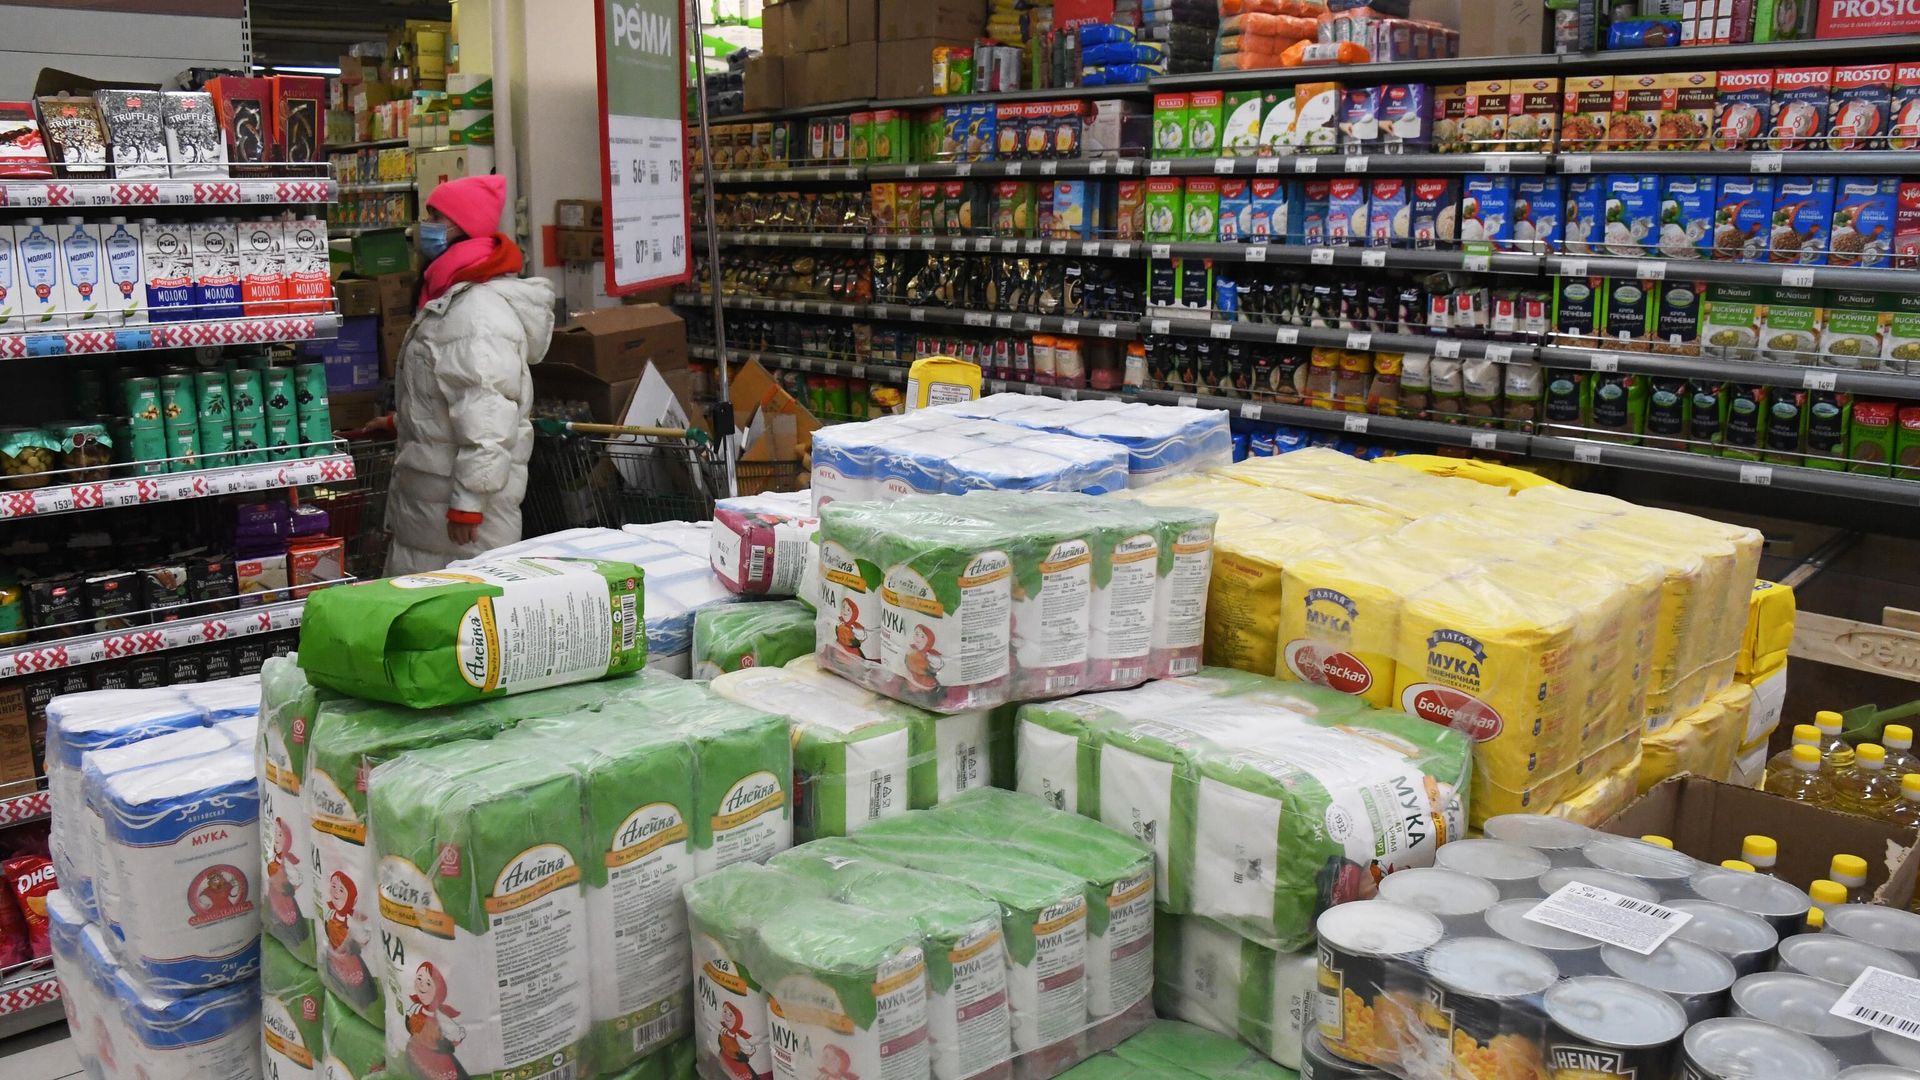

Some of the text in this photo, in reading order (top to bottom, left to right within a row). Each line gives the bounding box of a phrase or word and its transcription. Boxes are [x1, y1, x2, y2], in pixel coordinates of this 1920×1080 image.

[1720, 74, 1770, 86] PROSTO
[1776, 71, 1829, 84] PROSTO
[1836, 69, 1891, 82] PROSTO
[1052, 104, 1079, 112] PROSTO
[50, 118, 96, 128] TRUFFLES
[113, 113, 158, 124] TRUFFLES
[170, 114, 212, 122] TRUFFLES
[633, 158, 642, 184] 56
[27, 196, 42, 206] 139
[92, 196, 106, 206] 139
[176, 194, 189, 204] 139
[257, 194, 270, 202] 189
[27, 252, 52, 263] МОЛОКО
[70, 251, 94, 262] МОЛОКО
[112, 250, 136, 260] МОЛОКО
[636, 240, 644, 264] 87
[204, 288, 234, 300] МОЛОКО
[252, 284, 280, 296] МОЛОКО
[296, 283, 324, 294] МОЛОКО
[158, 289, 188, 302] МОЛОКО
[1770, 310, 1812, 318] BUCKWHEAT
[1832, 313, 1876, 322] BUCKWHEAT
[306, 475, 316, 483] 85
[819, 468, 836, 480] МУКА
[228, 482, 238, 492] 84
[266, 479, 276, 488] 84
[888, 483, 907, 494] МУКА
[178, 488, 188, 497] 85
[54, 500, 68, 510] 153
[120, 495, 134, 504] 157
[1307, 608, 1350, 632] МУКА
[188, 636, 196, 644] 49
[466, 614, 485, 681] Алейка
[90, 652, 100, 660] 49
[178, 664, 194, 672] JUST
[1428, 652, 1480, 678] МУКА
[1, 667, 10, 676] 47
[1427, 666, 1480, 687] ПШЕНИЧНАЯ
[1418, 697, 1496, 730] Беляевская
[726, 782, 776, 812] Алейка
[1390, 776, 1426, 848] МУКА
[1334, 814, 1347, 834] 1932
[620, 813, 676, 848] Алейка
[192, 830, 228, 846] МУКА
[503, 855, 566, 892] Алейка
[1110, 904, 1134, 920] МУКА
[1037, 934, 1062, 950] МУКА
[954, 960, 981, 978] МУКА
[878, 992, 906, 1012] МУКА
[772, 1022, 814, 1058] МУКА
[1556, 1051, 1615, 1072] HEINZ
